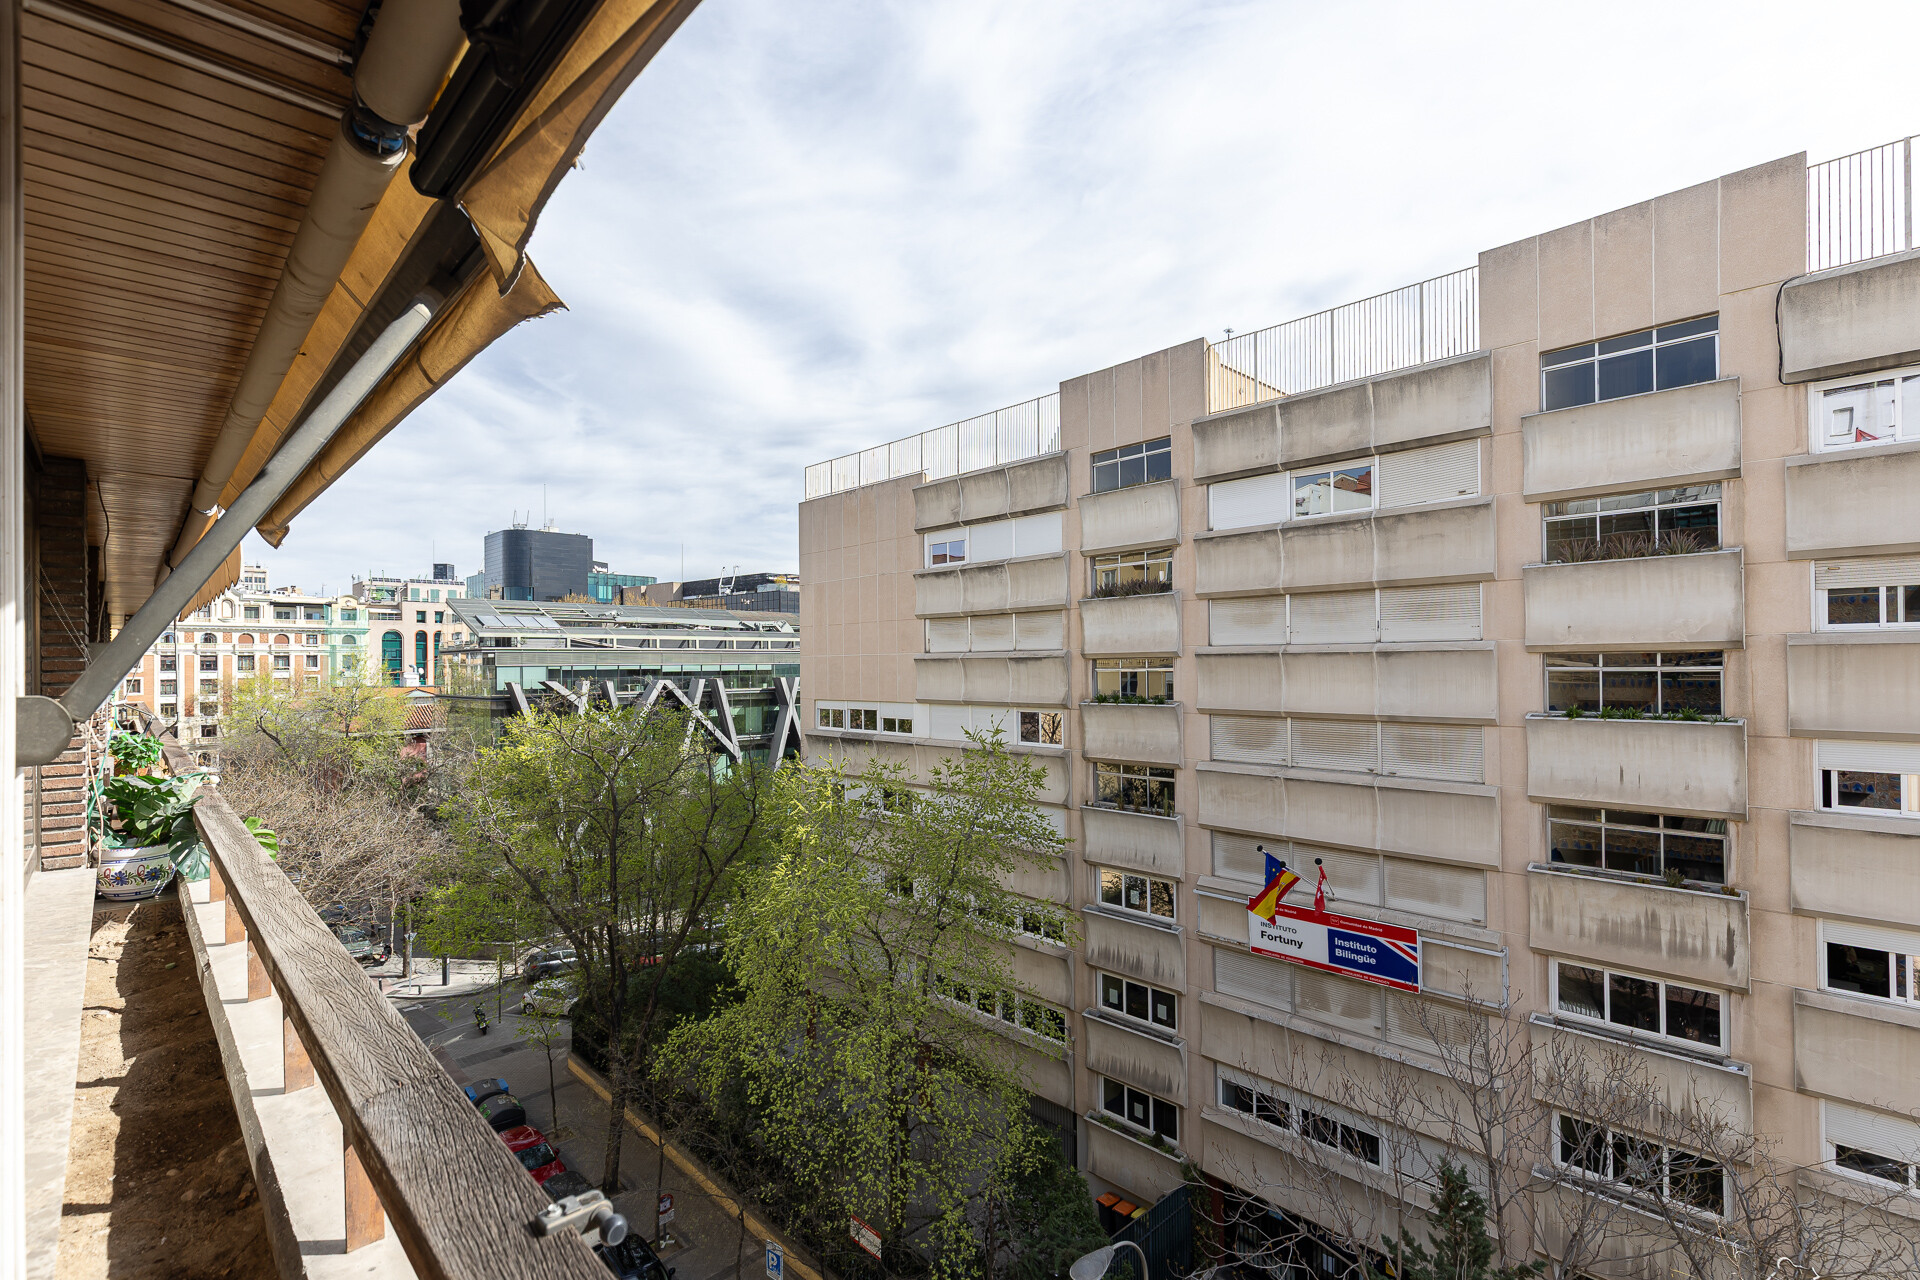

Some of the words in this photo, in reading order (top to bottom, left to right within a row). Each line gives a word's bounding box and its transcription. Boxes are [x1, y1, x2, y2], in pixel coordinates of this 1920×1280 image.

[1261, 930, 1304, 949] Fortuny
[1335, 937, 1377, 953] Instituto
[1335, 949, 1376, 964] Bilingüe
[769, 1252, 777, 1268] P
